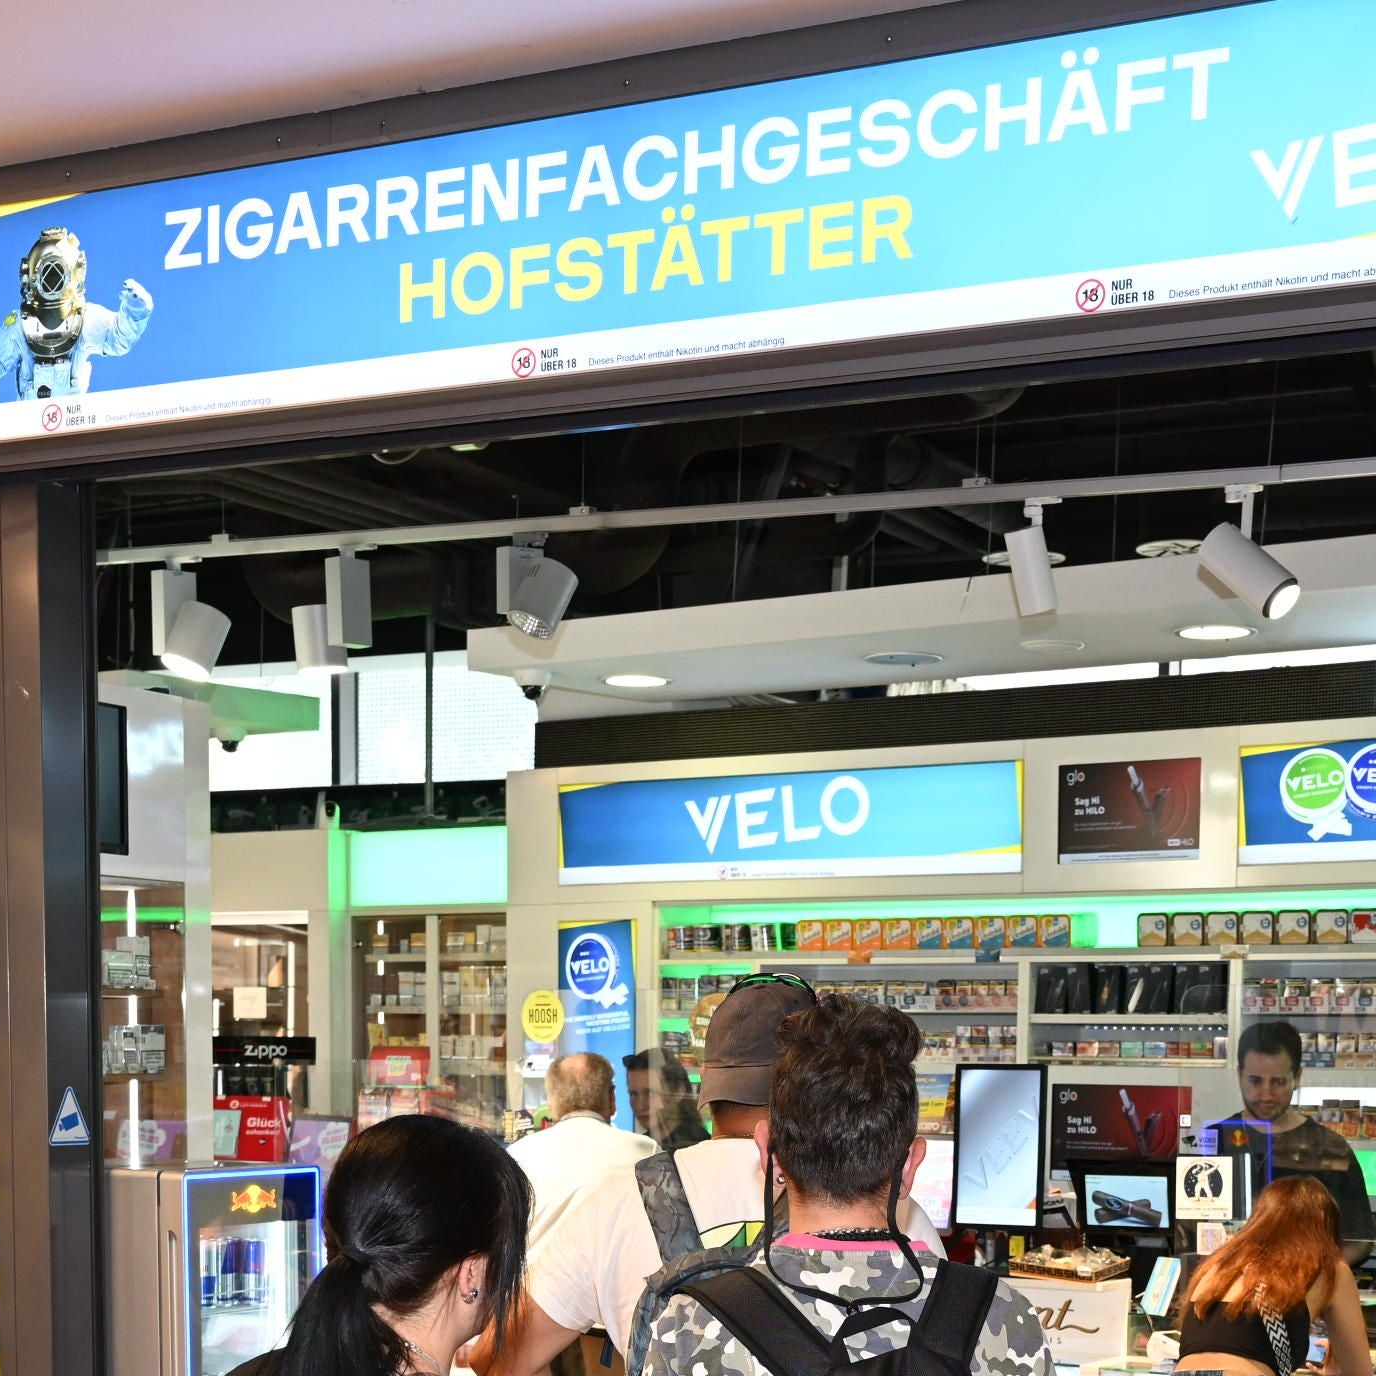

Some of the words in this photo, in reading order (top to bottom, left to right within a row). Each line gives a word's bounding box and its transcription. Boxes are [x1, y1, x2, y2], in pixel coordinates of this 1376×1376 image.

[164, 48, 1230, 270] ZIGARRENFACHGESCHÄFT
[400, 195, 913, 324] HOFSTÄTTER
[1111, 279, 1133, 291] NUR
[1169, 287, 1200, 299] Dieses
[1203, 283, 1239, 295] Produkt
[1241, 279, 1273, 292] enthält
[1275, 275, 1308, 287] Nikotin
[1311, 272, 1329, 283] und
[1331, 269, 1361, 281] macht
[1111, 291, 1138, 305] ÜBER
[1142, 290, 1155, 302] 18
[541, 348, 559, 359] NUR
[588, 355, 615, 367] Dieses
[616, 351, 646, 364] Produkt
[648, 348, 674, 360] enthält
[676, 345, 703, 357] Nikotin
[704, 343, 720, 354] und
[722, 341, 746, 352] macht
[541, 358, 565, 372] ÜBER
[567, 358, 577, 369] 18
[67, 404, 82, 415] NUR
[66, 413, 86, 427] ÜBER
[1067, 769, 1086, 787] glo
[1287, 769, 1345, 793] VELO
[1074, 797, 1090, 807] Sag
[1091, 796, 1100, 804] Hi
[685, 776, 871, 855] VELO
[1074, 808, 1085, 816] zu
[1085, 806, 1105, 815] HILO
[570, 959, 610, 976] VELO
[528, 1008, 558, 1024] HOOSH
[1060, 1088, 1078, 1105] glo
[246, 1116, 282, 1129] Glück
[1067, 1115, 1084, 1127] Sag
[1084, 1115, 1092, 1124] Hi
[1067, 1126, 1077, 1134] zu
[1078, 1125, 1097, 1135] HILO
